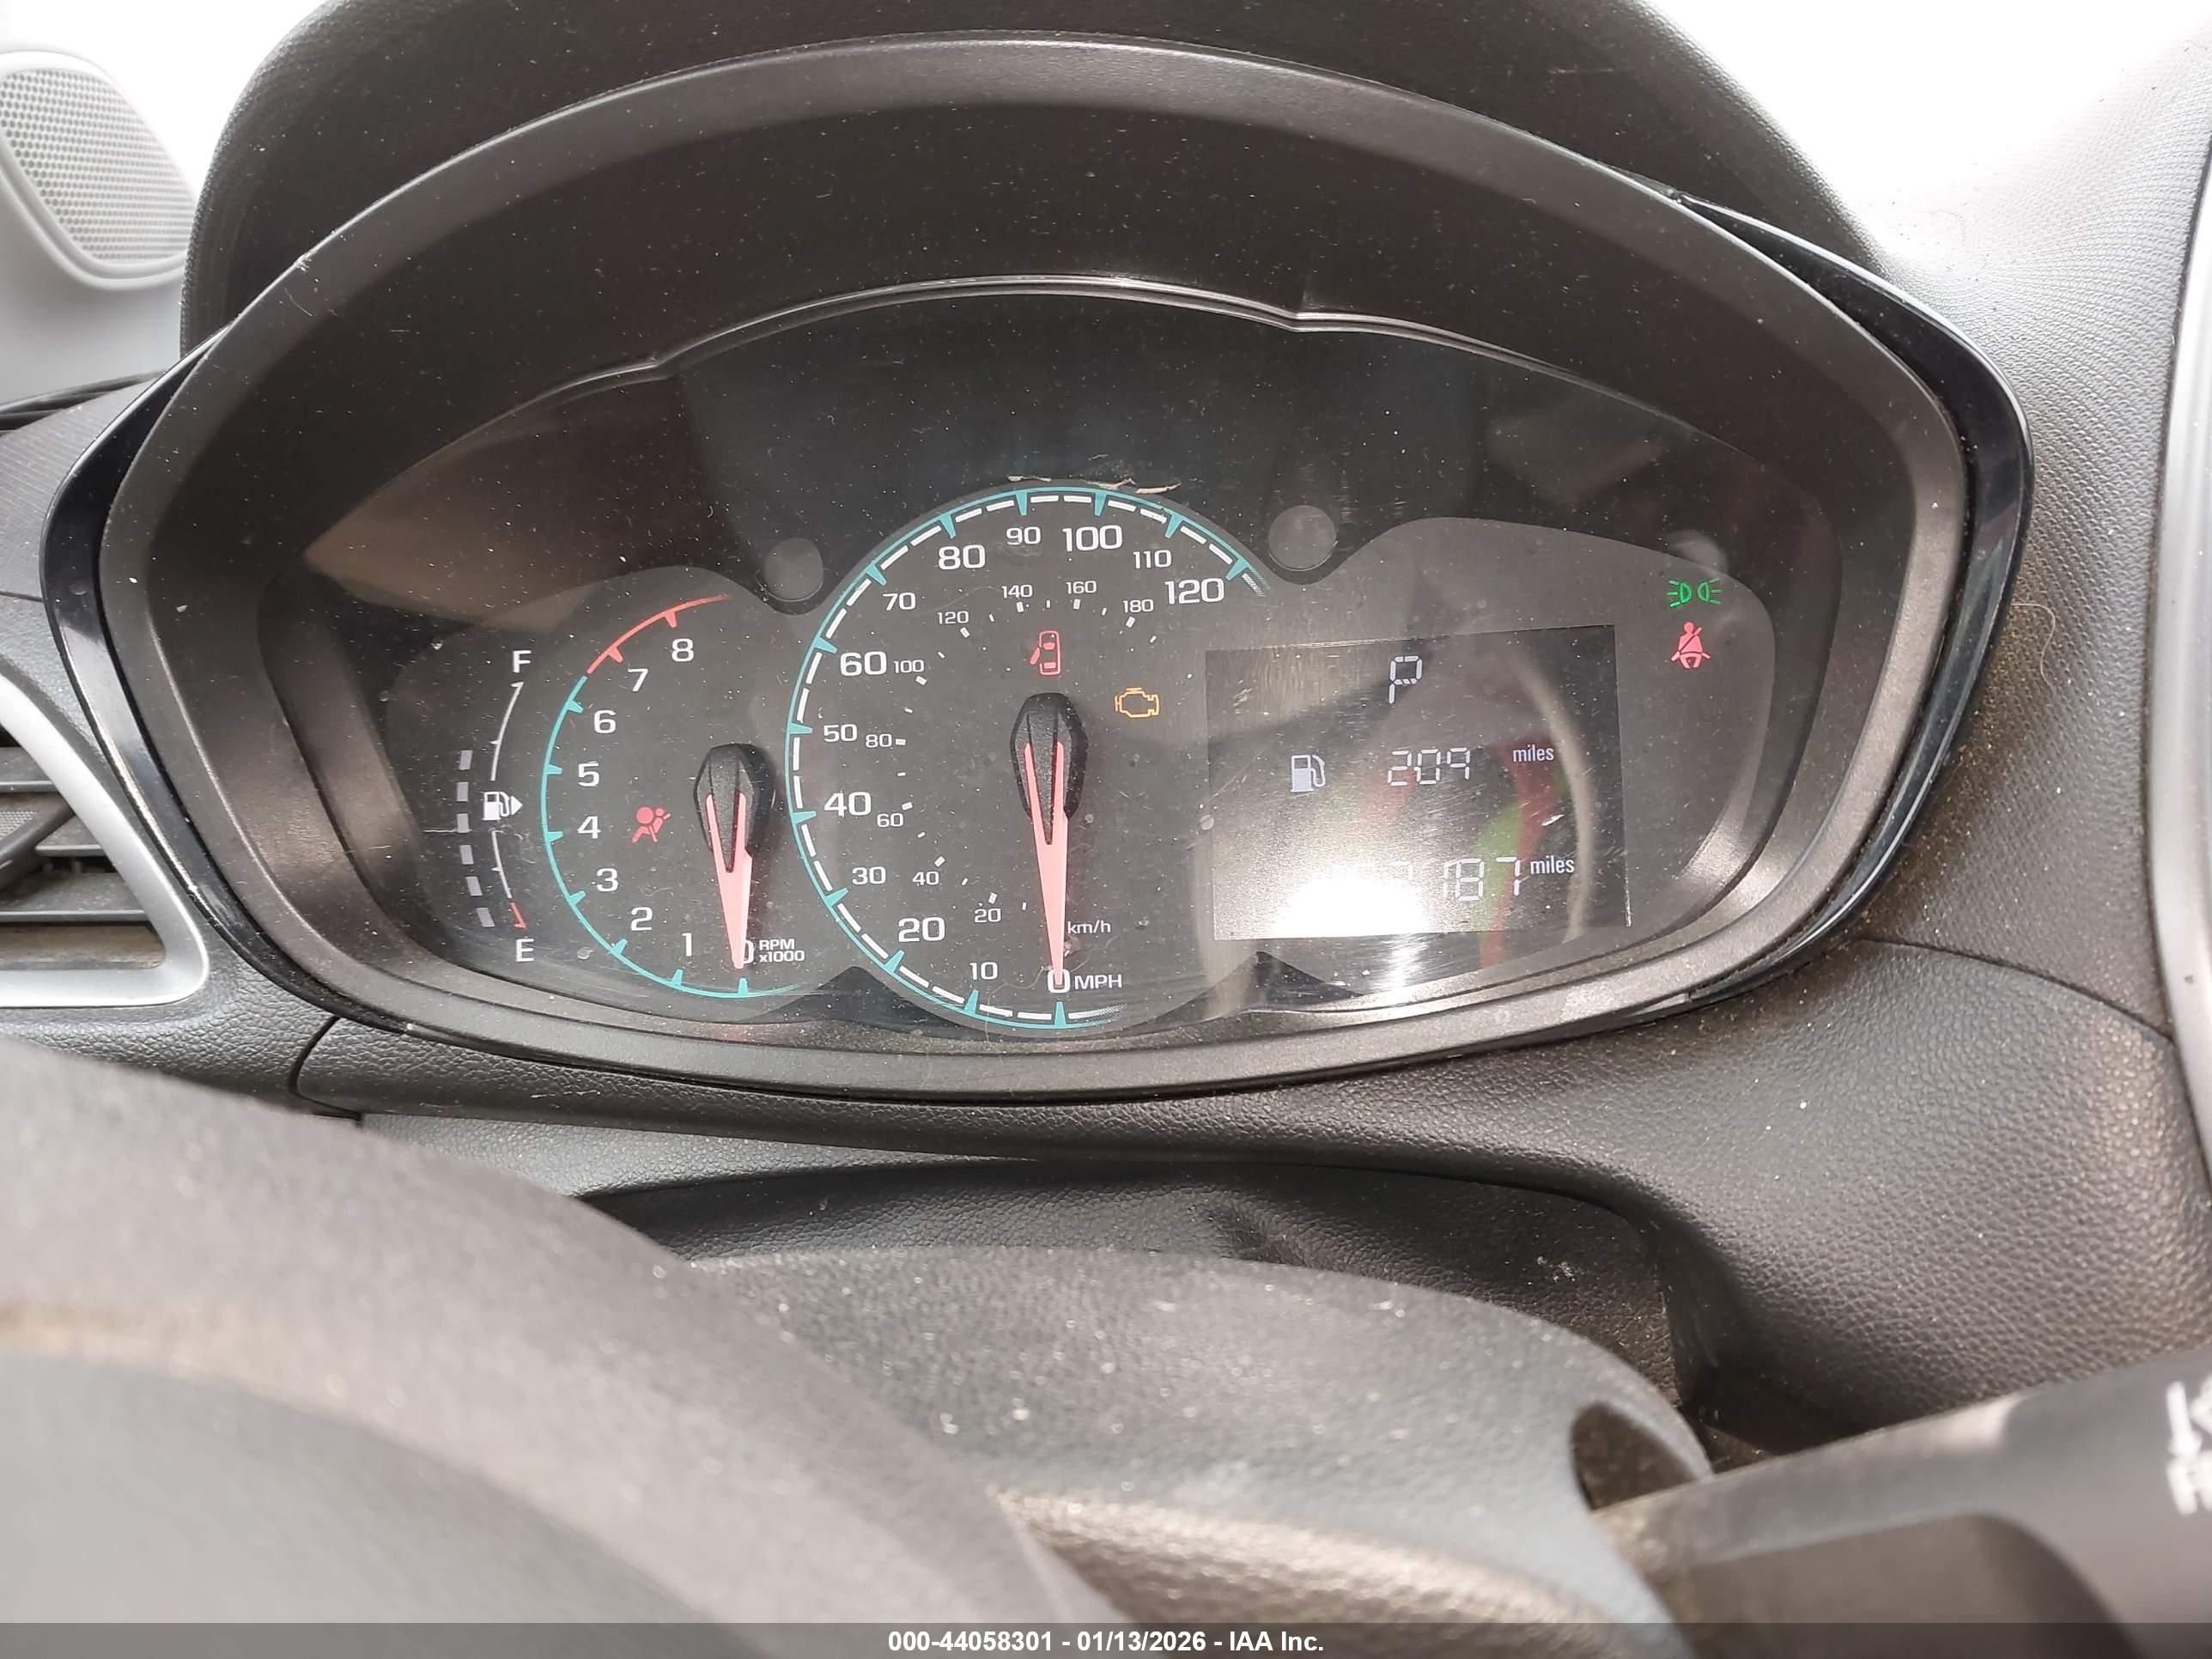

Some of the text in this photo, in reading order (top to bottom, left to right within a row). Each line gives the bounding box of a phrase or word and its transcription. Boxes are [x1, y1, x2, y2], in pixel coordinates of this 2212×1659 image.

[1006, 526, 1042, 545] 90
[1062, 525, 1123, 552] 100
[938, 544, 986, 570] 80
[1133, 550, 1172, 569] 110
[1001, 584, 1033, 599] 140
[1066, 580, 1097, 594] 160
[1164, 577, 1224, 605] 120
[883, 592, 916, 611] 70
[1122, 599, 1154, 613] 180
[937, 611, 969, 624] 120
[672, 638, 695, 662] 8
[513, 649, 532, 673] F
[840, 651, 887, 677] 60
[893, 659, 925, 674] 100
[628, 668, 648, 692] 7
[1389, 655, 1423, 704] P
[593, 709, 617, 734] 6
[823, 723, 858, 743] 50
[865, 733, 892, 748] 80
[578, 763, 600, 787] 5
[1387, 745, 1554, 787] 209 miles
[823, 791, 872, 818] 40
[577, 816, 601, 839] 4
[877, 812, 904, 828] 60
[852, 866, 886, 885] 30
[1530, 857, 1575, 875] miles
[596, 867, 619, 892] 3
[912, 871, 939, 885] 40
[630, 907, 653, 932] 2
[974, 908, 1001, 923] 20
[898, 916, 945, 943] 20
[1067, 919, 1111, 934] km/h
[515, 938, 535, 963] E
[682, 933, 692, 957] 1
[759, 939, 795, 951] RPM
[759, 950, 805, 963] x1000
[969, 962, 998, 981] 10
[1047, 965, 1122, 994] 0 MPH
